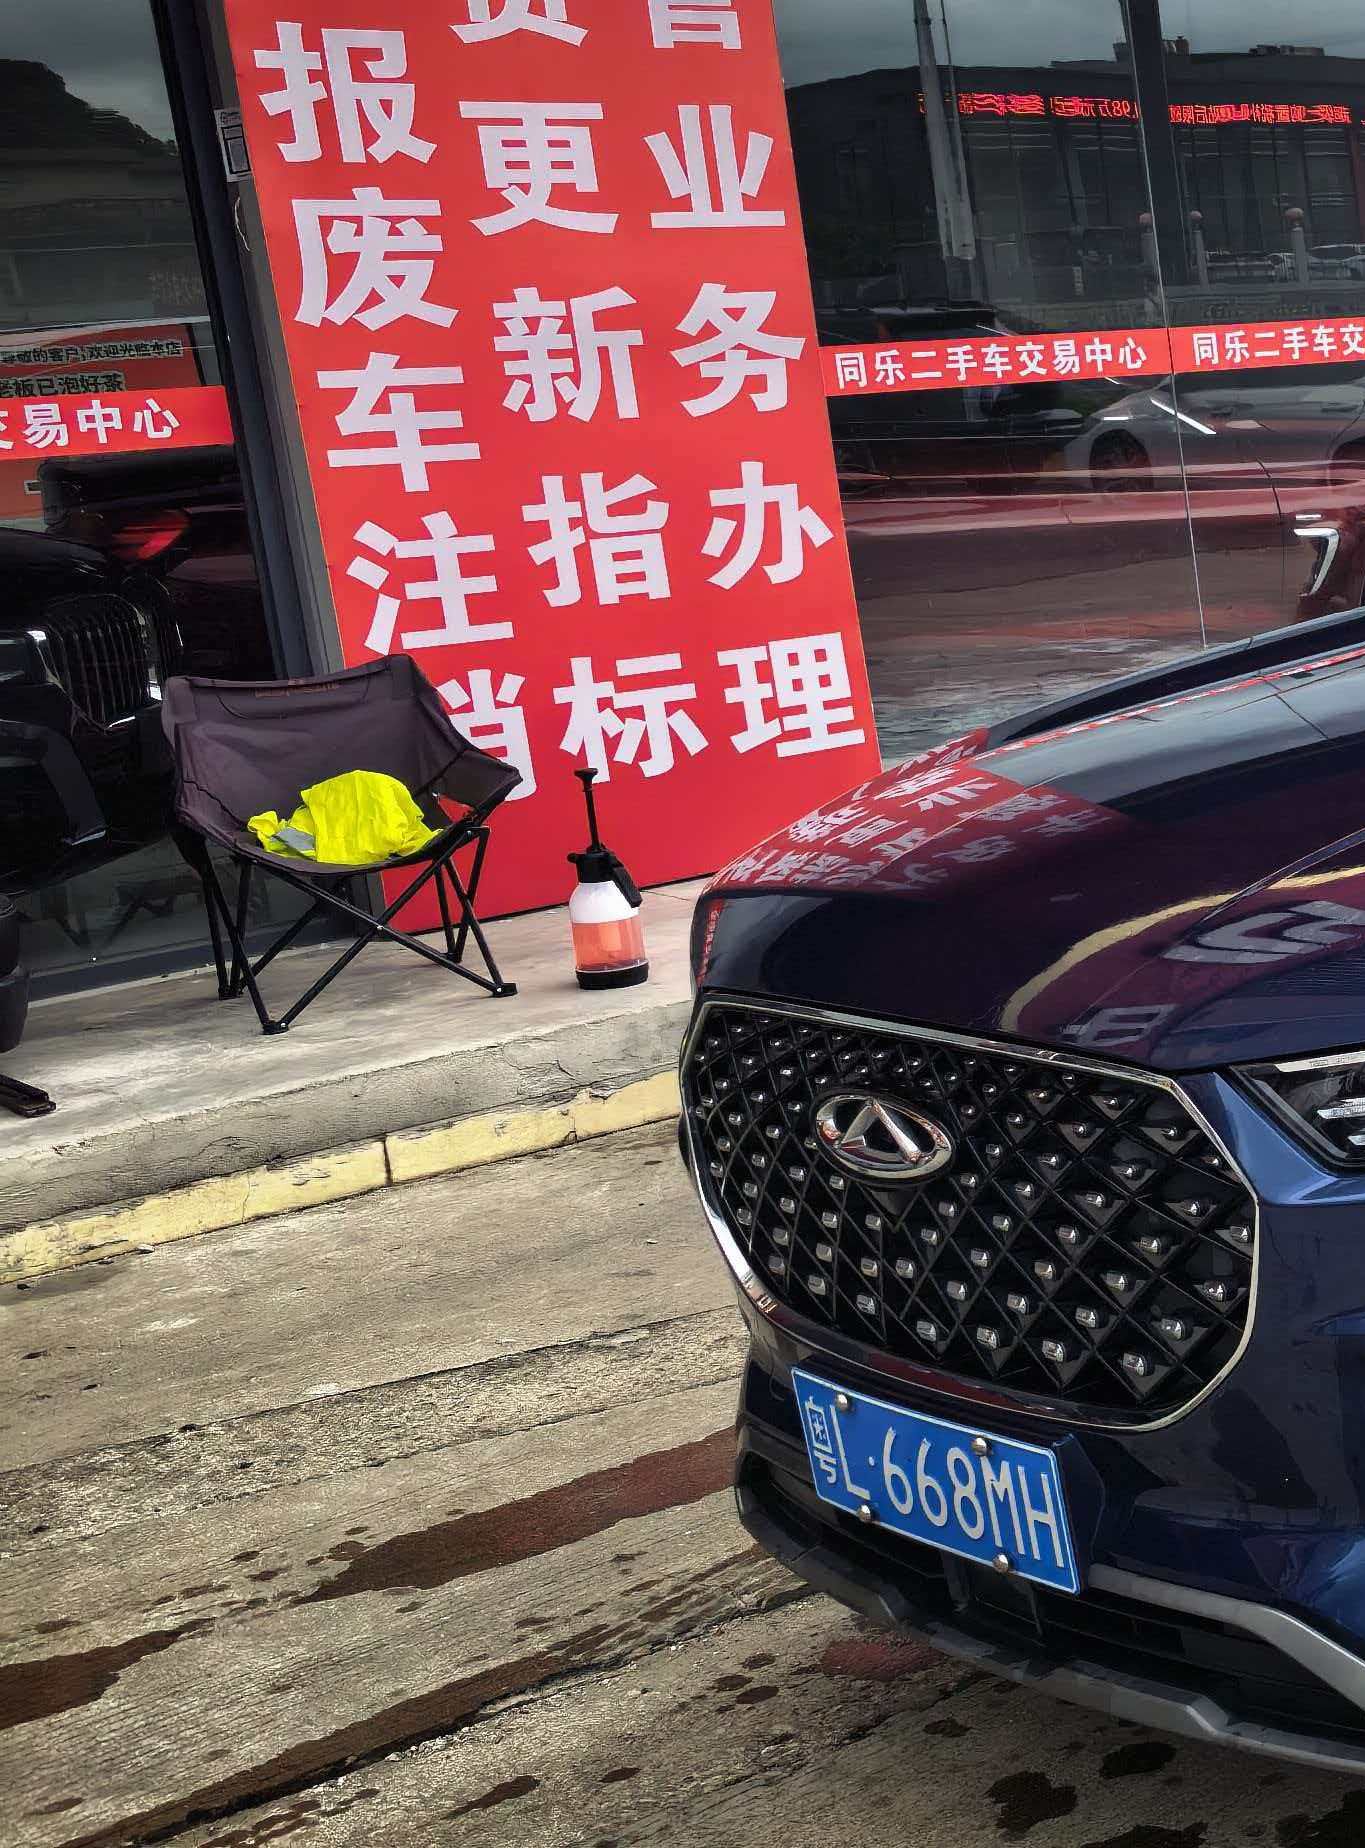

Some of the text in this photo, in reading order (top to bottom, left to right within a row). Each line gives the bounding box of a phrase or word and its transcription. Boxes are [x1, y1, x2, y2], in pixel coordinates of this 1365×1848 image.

[835, 336, 1148, 389] 同乐二手车交易中心
